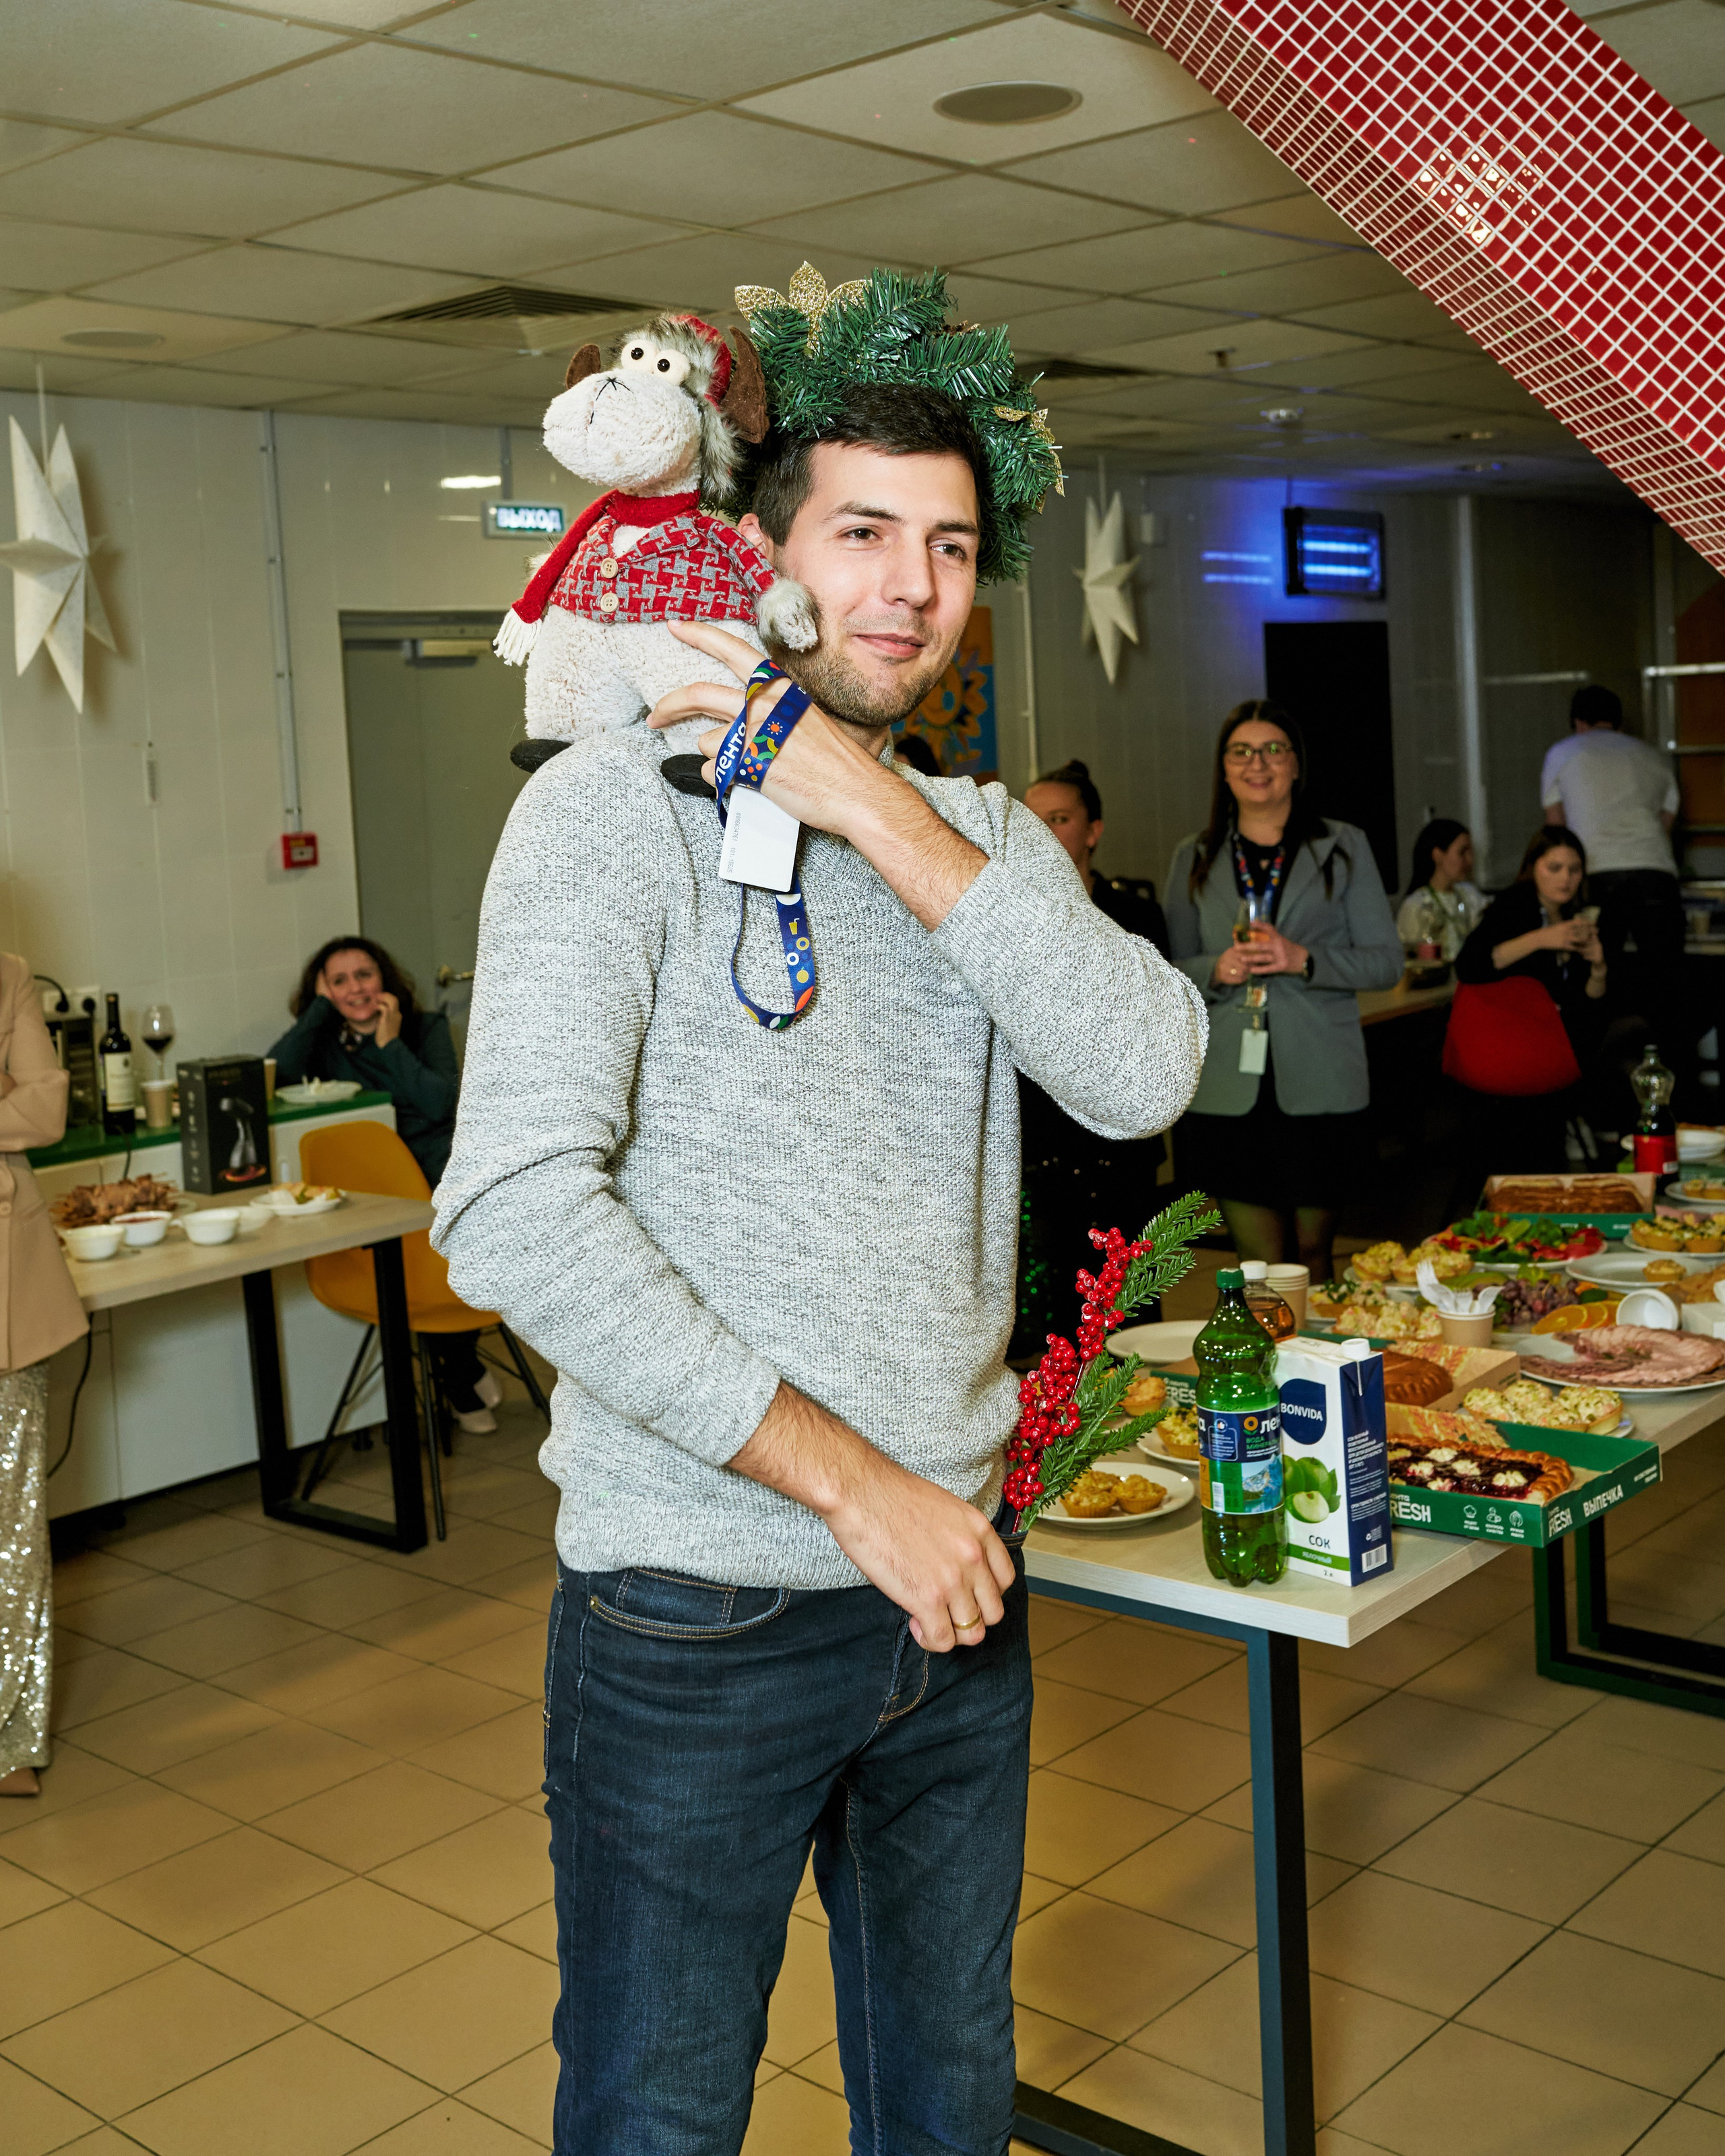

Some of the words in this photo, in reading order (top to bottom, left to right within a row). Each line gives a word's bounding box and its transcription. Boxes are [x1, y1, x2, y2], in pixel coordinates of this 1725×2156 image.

[497, 507, 562, 532] ВЫХОД
[716, 722, 747, 784] лента
[1166, 1386, 1196, 1404] FRES
[1280, 1403, 1323, 1422] BONVIDA
[1389, 1500, 1431, 1523] RESH
[1583, 1484, 1624, 1517] ВЫПЕЧКА
[1309, 1535, 1331, 1549] СОК
